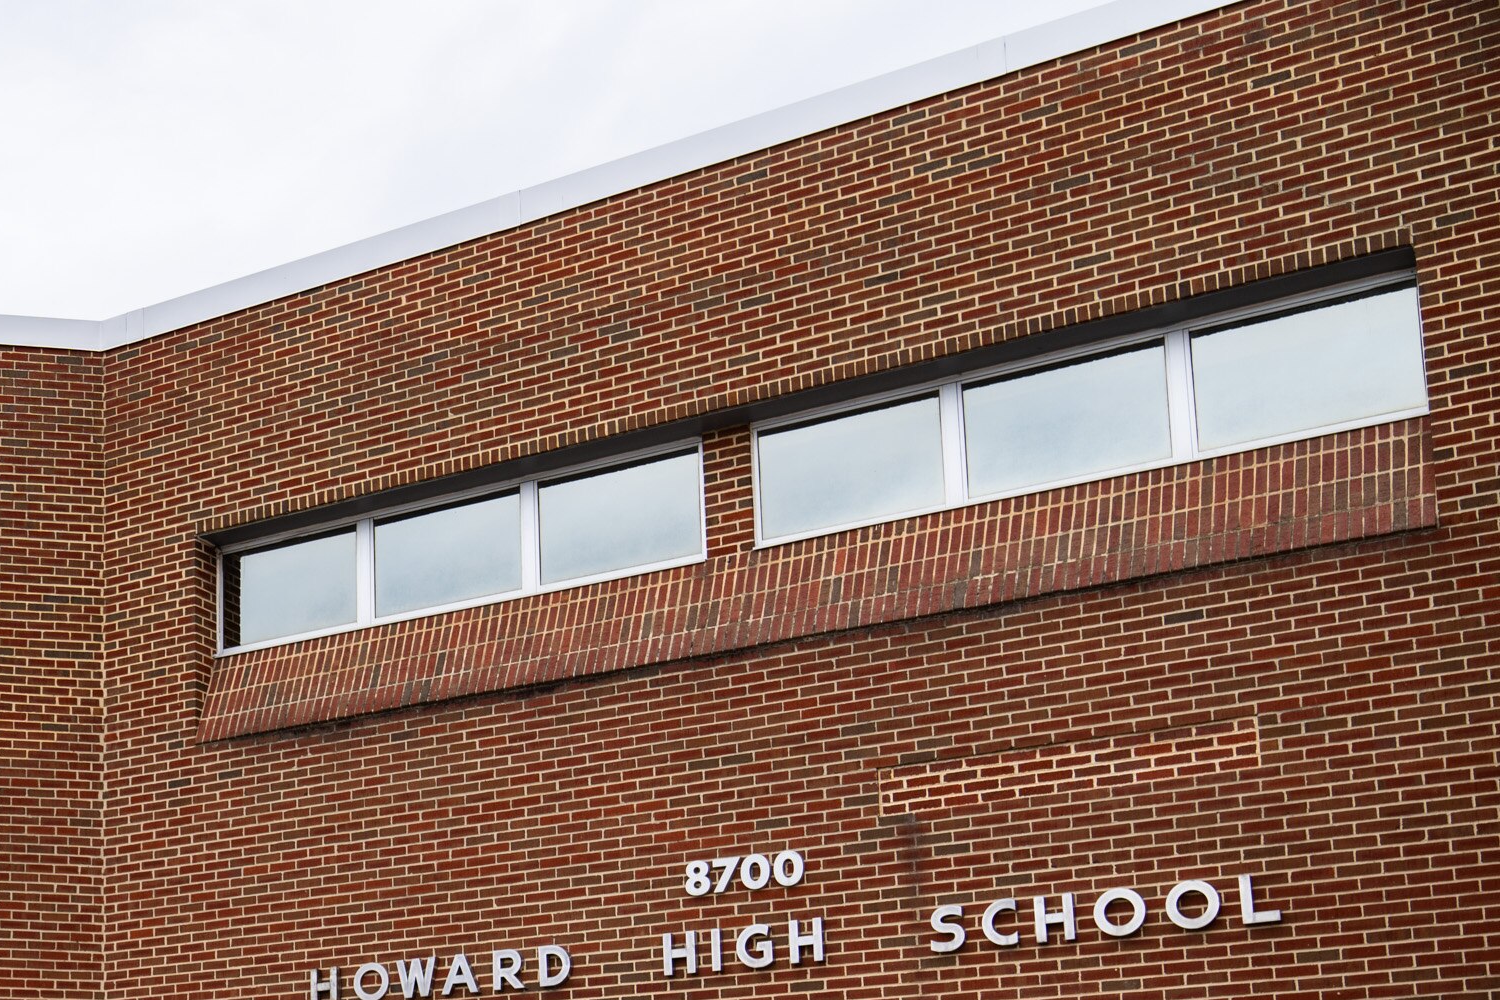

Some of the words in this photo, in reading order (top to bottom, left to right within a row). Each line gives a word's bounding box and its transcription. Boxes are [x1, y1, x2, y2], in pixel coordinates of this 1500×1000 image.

[683, 850, 805, 896] 8700
[662, 916, 825, 977] HIGH
[930, 873, 1283, 953] SCHOOL
